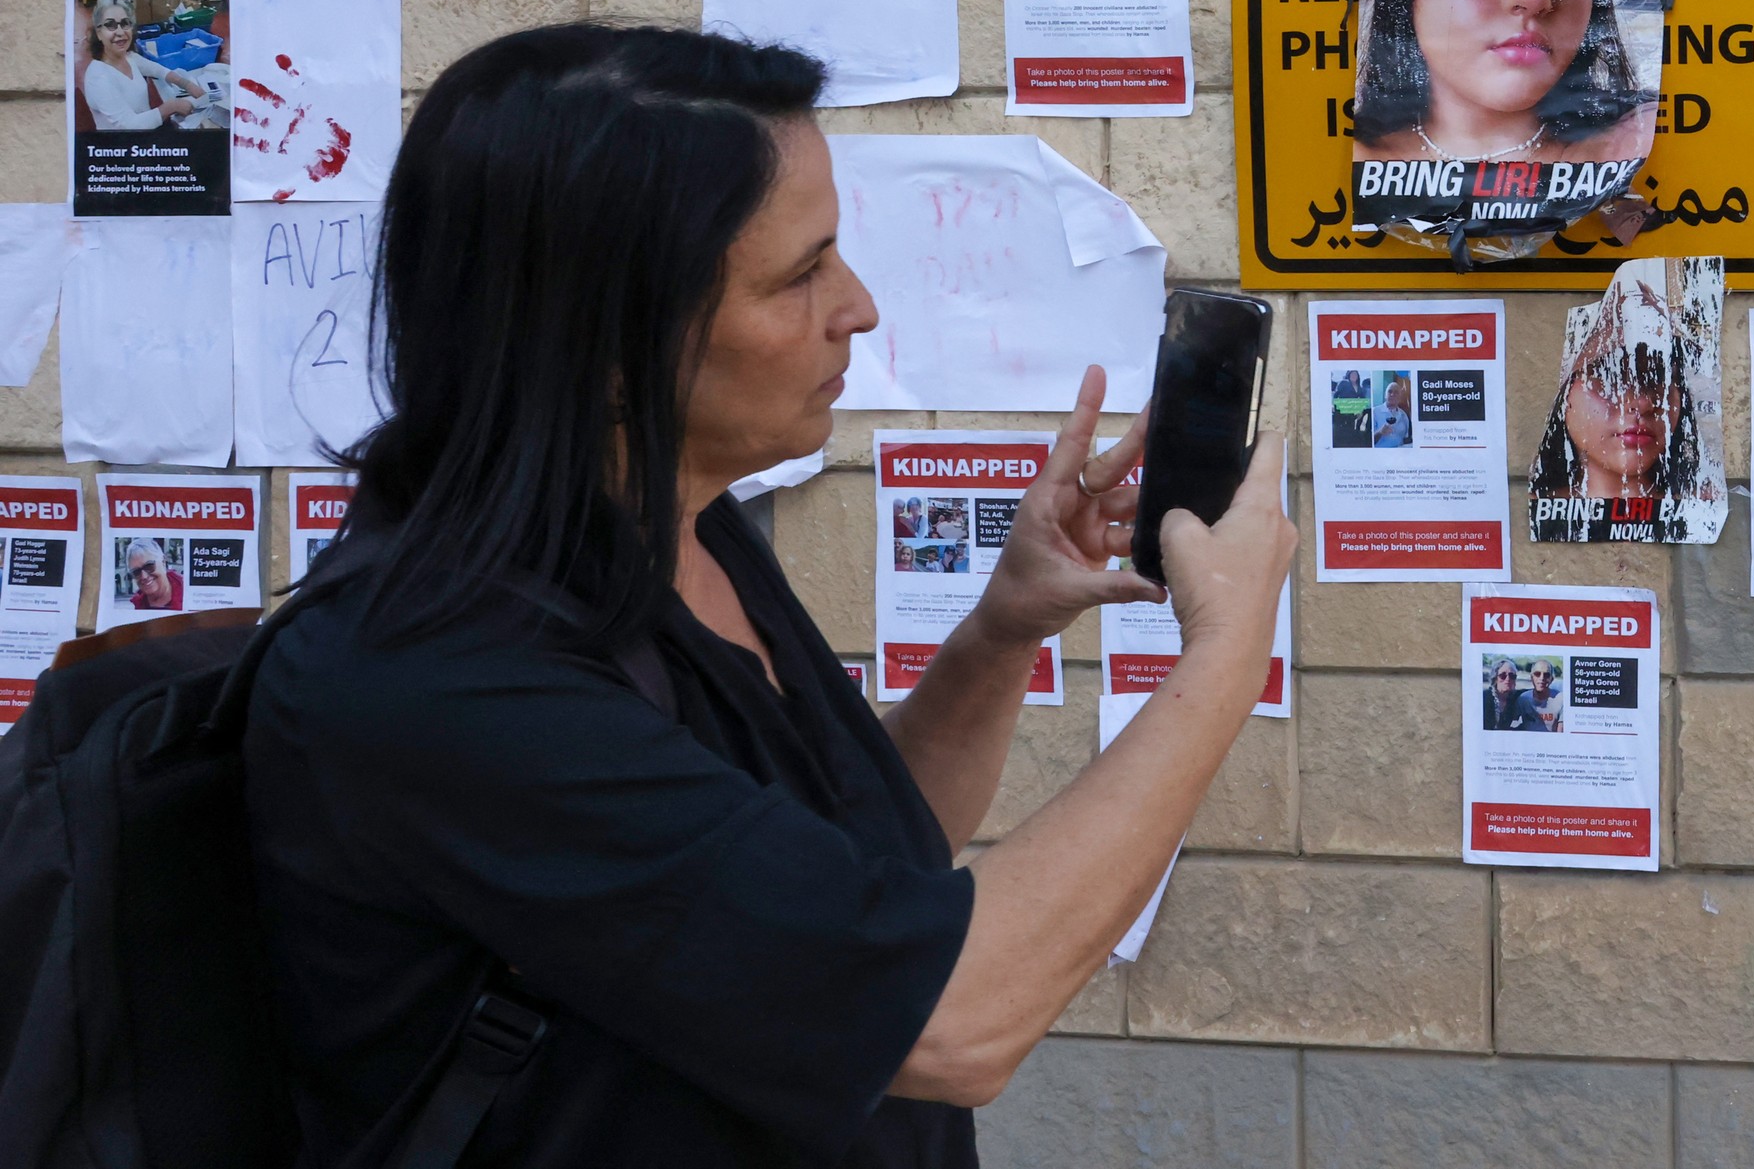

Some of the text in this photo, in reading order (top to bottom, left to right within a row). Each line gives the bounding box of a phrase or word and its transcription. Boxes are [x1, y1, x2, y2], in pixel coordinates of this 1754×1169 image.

[88, 145, 188, 157] Tamar Suchman
[136, 164, 171, 173] grandma
[1358, 157, 1642, 199] BRING LIRI BACK
[88, 185, 130, 194] kidnapped
[132, 185, 141, 193] by
[1471, 201, 1539, 220] NOW!
[312, 309, 347, 367] 2
[1331, 330, 1483, 349] KIDNAPPED
[893, 458, 1037, 478] KIDNAPPED
[0, 502, 68, 520] APPED
[114, 501, 246, 519] KIDNAPPED
[1536, 498, 1605, 521] BRING
[1611, 497, 1654, 520] LIRI
[1610, 523, 1654, 540] NOW!
[194, 547, 229, 557] Ada Sagi
[194, 558, 239, 568] 75-years-old
[1484, 613, 1639, 636] KIDNAPPED
